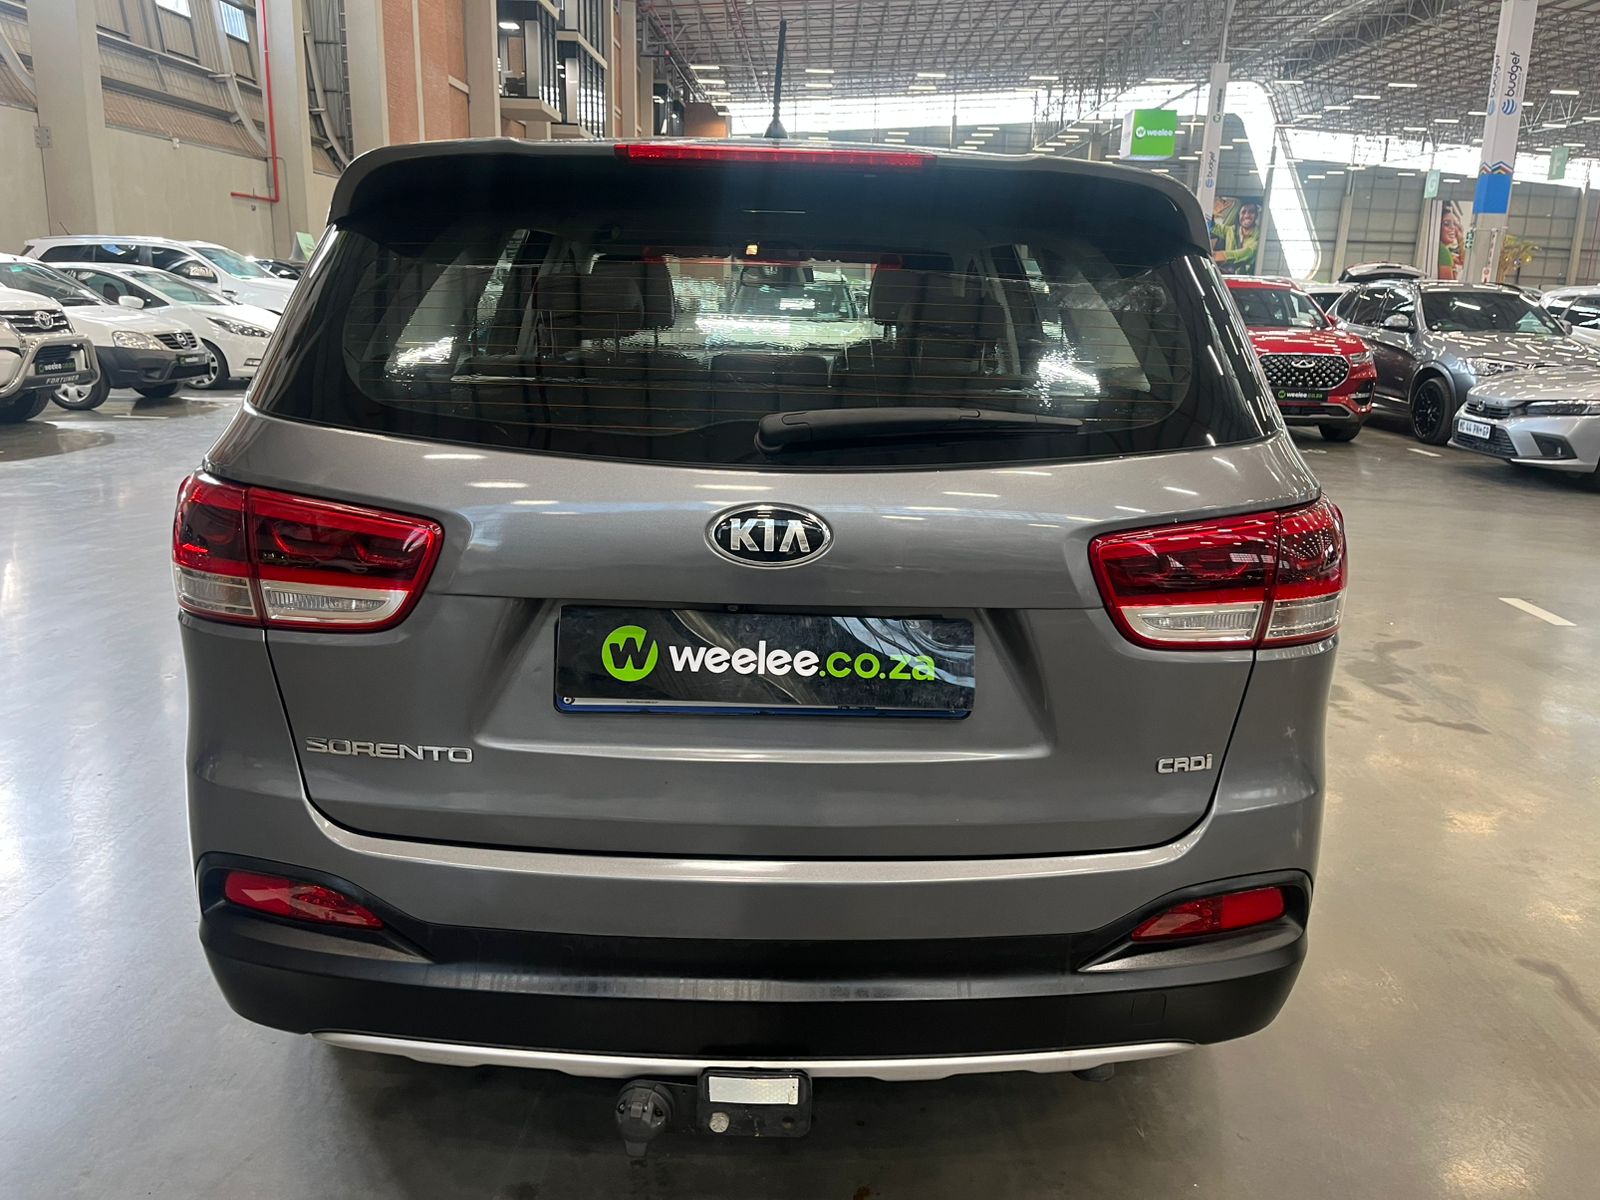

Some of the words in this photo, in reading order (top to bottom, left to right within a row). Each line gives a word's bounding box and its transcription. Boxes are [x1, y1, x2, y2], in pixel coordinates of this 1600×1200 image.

[1505, 51, 1522, 97] budget
[1146, 128, 1174, 137] weelee
[45, 374, 79, 384] FORTUNER
[730, 518, 811, 552] KIA
[669, 640, 936, 681] weelee.co.za
[306, 737, 473, 763] SORENTO
[1158, 753, 1213, 773] CRDi
